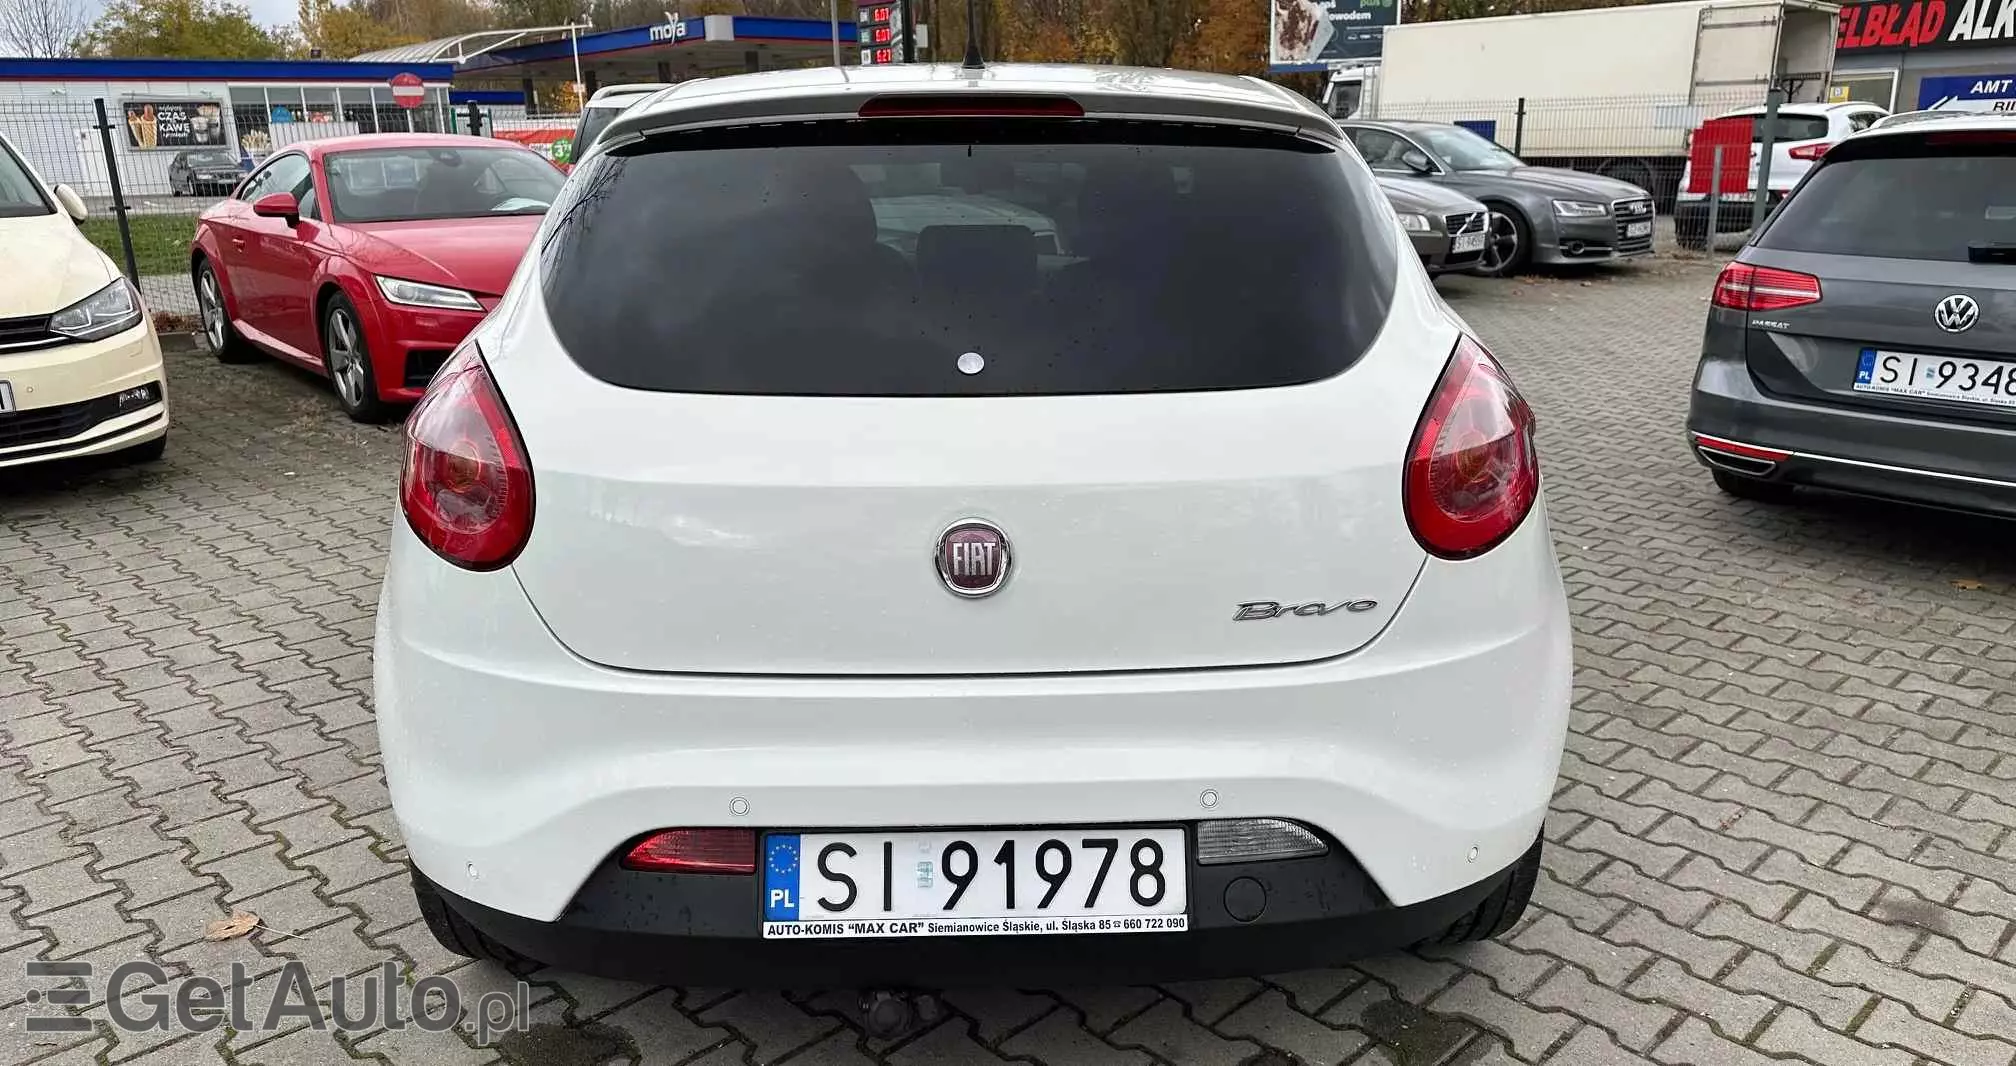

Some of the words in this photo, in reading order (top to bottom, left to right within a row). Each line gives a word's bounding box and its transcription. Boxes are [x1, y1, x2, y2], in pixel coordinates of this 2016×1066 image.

[1970, 80, 2013, 94] AMT
[157, 112, 187, 122] CZAS
[1859, 371, 1871, 380] PL
[1880, 356, 1918, 386] SI
[952, 541, 996, 576] FIAT
[1232, 599, 1378, 621] Bravo
[770, 889, 795, 909] PL
[817, 841, 893, 912] SI
[941, 838, 1166, 911] 91978
[767, 923, 844, 936] AUTO-KOMIS
[928, 921, 1000, 933] Siemianowice
[1046, 921, 1059, 931] ul.
[1062, 918, 1096, 934] Śląska
[1099, 919, 1111, 930] 85
[1123, 918, 1142, 929] 660
[1145, 918, 1164, 929] 722
[1166, 918, 1185, 929] 090
